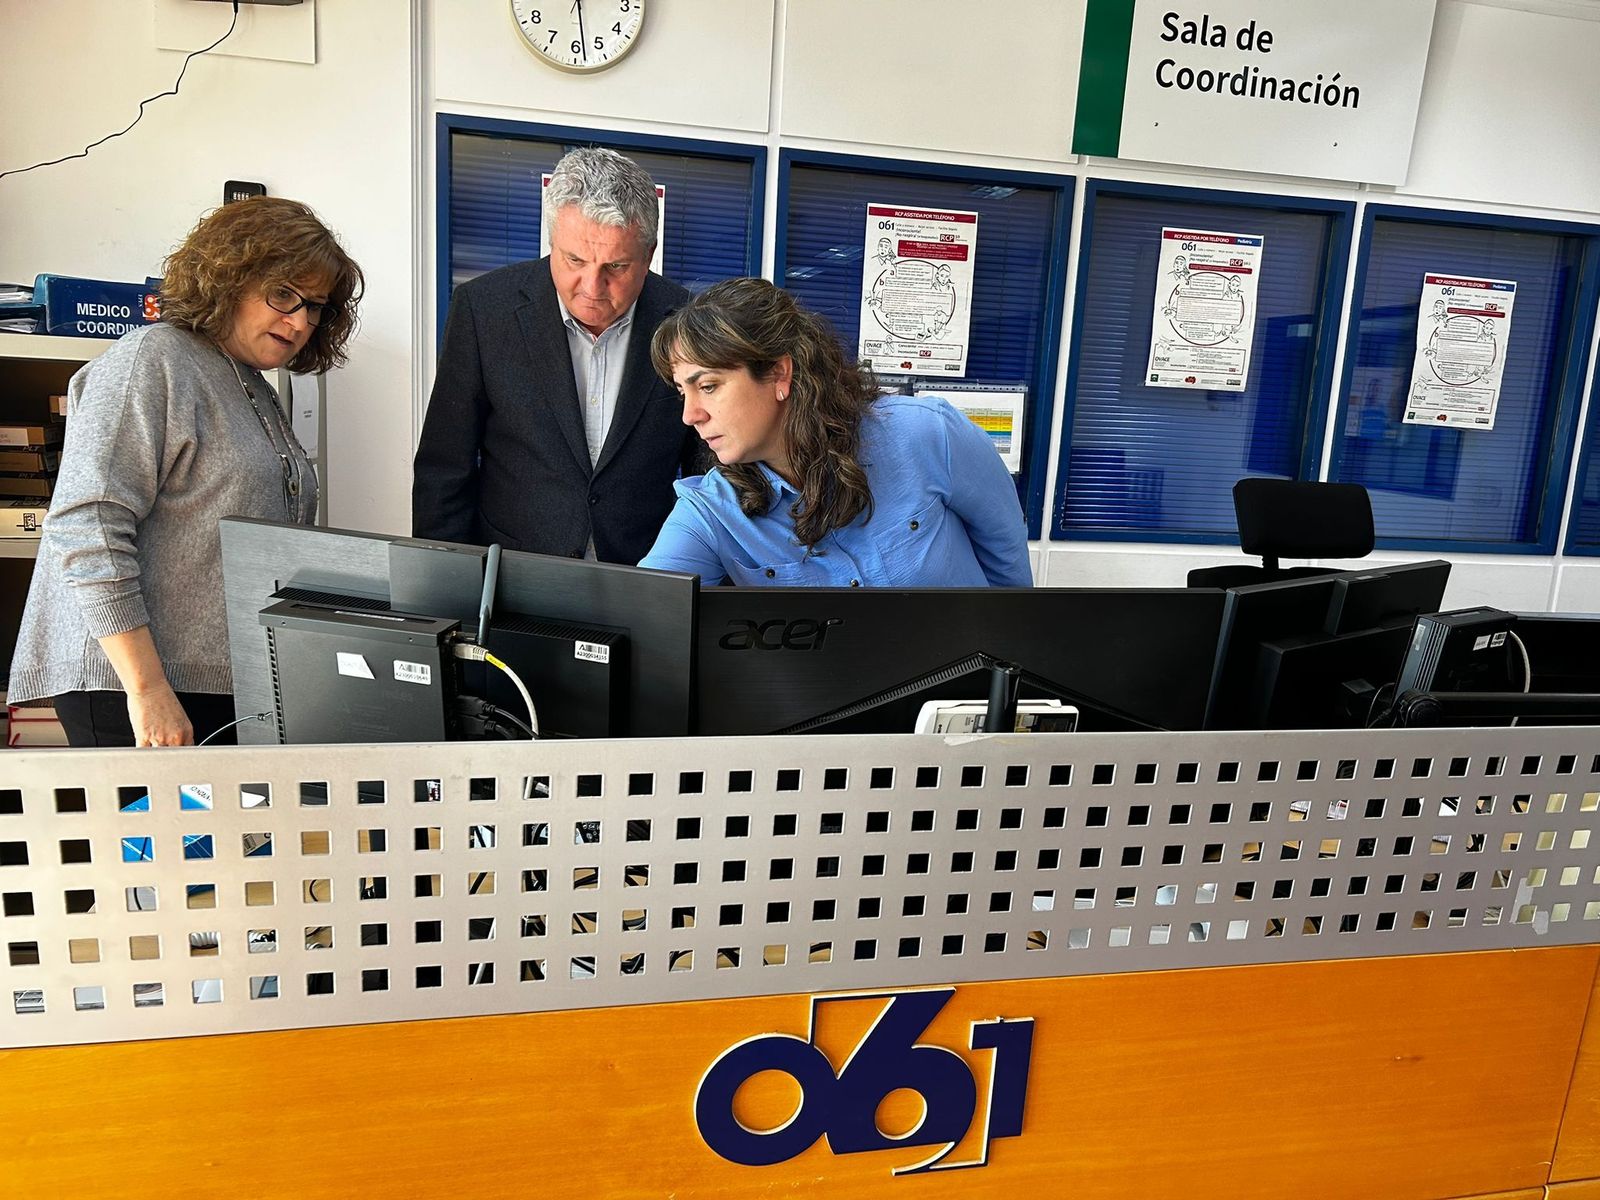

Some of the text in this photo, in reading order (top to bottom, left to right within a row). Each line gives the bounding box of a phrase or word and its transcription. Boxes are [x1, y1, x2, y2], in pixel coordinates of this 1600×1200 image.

[620, 0, 630, 12] 3
[531, 10, 541, 24] 8
[612, 22, 621, 35] 4
[1160, 12, 1273, 53] Sala de
[548, 30, 558, 44] 7
[594, 36, 604, 50] 5
[570, 40, 580, 54] 6
[1156, 58, 1360, 108] Coordinación
[878, 220, 895, 230] 061
[1182, 242, 1196, 251] 061
[1441, 287, 1455, 296] 061
[76, 302, 130, 318] MEDICO
[719, 619, 842, 650] acer
[694, 986, 1034, 1176] 061
